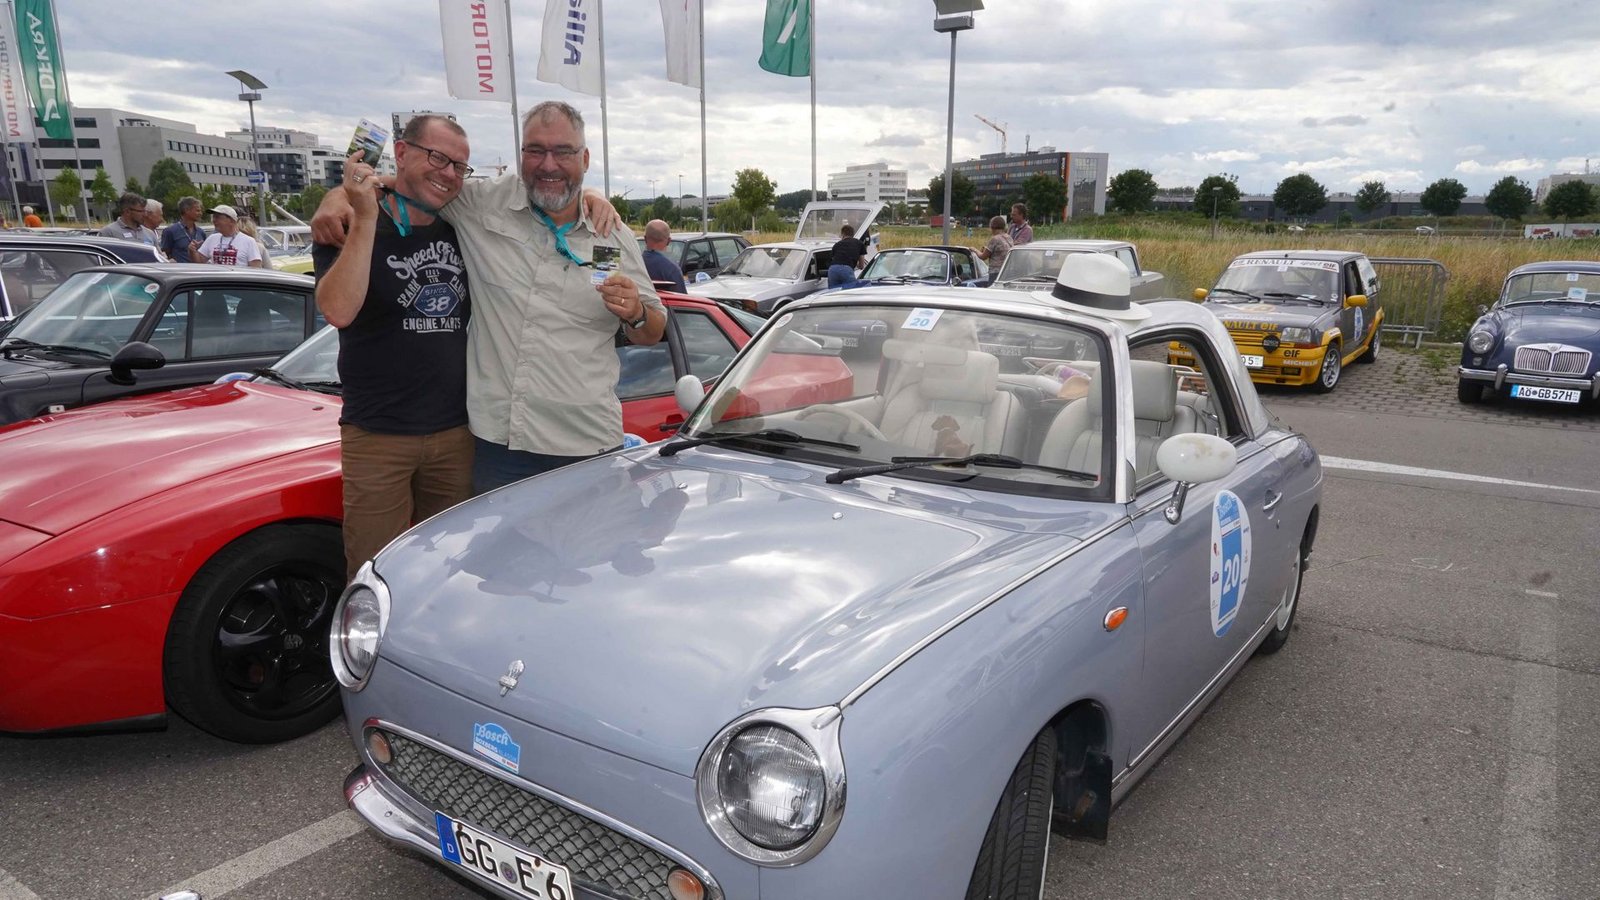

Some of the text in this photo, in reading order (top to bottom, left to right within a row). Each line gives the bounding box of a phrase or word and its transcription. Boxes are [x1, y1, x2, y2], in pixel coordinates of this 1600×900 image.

[386, 242, 437, 280] Speed
[396, 278, 421, 308] SPARK
[424, 286, 448, 295] SINCE
[424, 296, 451, 312] 38
[402, 317, 461, 331] ENGINE PARTS
[910, 317, 930, 327] 20
[1260, 323, 1279, 331] elf
[1283, 349, 1301, 358] elf
[1518, 386, 1532, 397] AÖ
[1222, 553, 1240, 596] 20
[476, 726, 509, 746] Bosch
[447, 842, 455, 853] D
[455, 829, 567, 900] GG E 6
